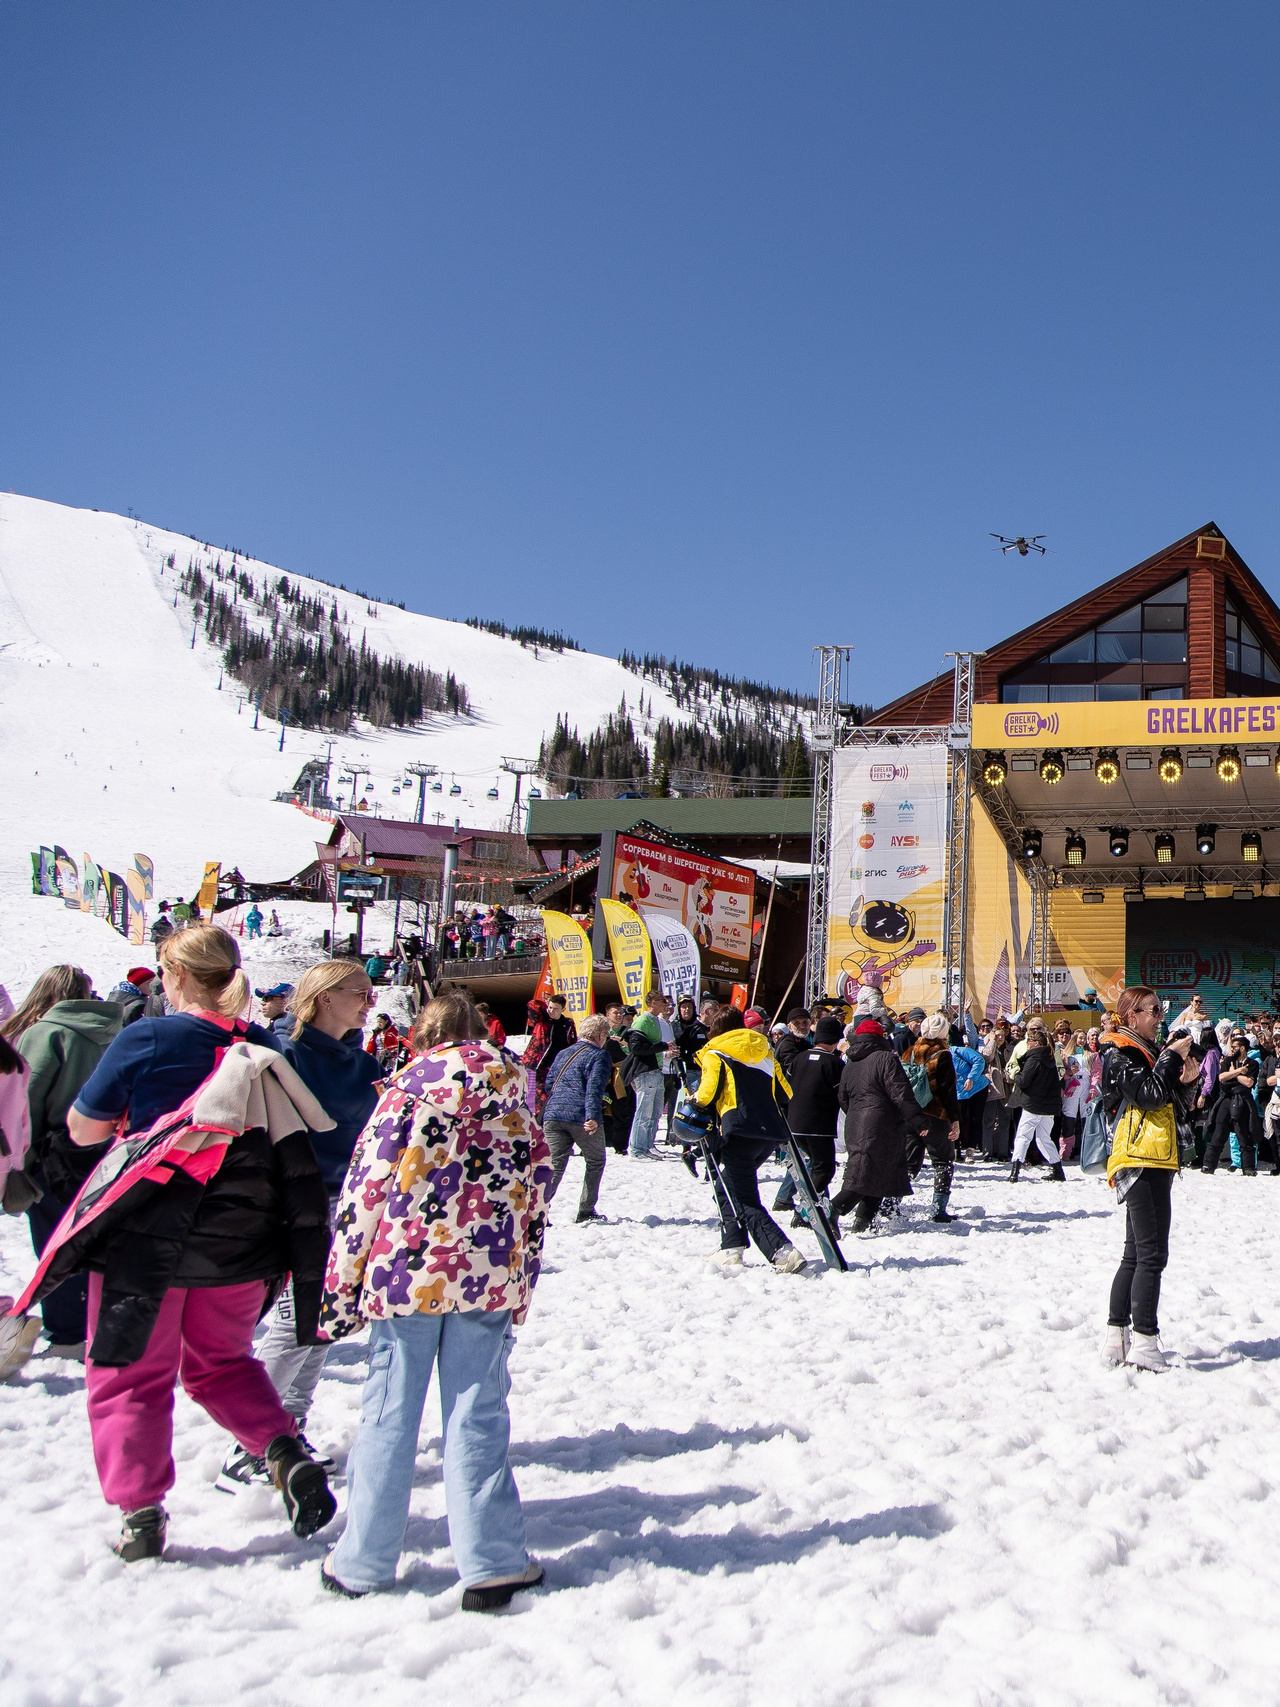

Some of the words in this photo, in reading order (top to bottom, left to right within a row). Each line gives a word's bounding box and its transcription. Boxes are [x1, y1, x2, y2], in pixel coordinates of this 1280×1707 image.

[1009, 715, 1036, 725] GRELKA
[1009, 724, 1028, 734] FEST
[891, 836, 919, 847] AYS!
[623, 843, 666, 862] СОГРЕВАЕМ
[667, 854, 673, 863] В
[674, 856, 710, 873] ШЕРЕГЕШЕ
[711, 867, 726, 878] УЖЕ
[727, 871, 734, 880] 10
[735, 873, 750, 884] ЛЕТ!
[865, 869, 887, 877] 2ГИС
[1150, 953, 1193, 968] GRELKA
[1150, 969, 1177, 984] FEST
